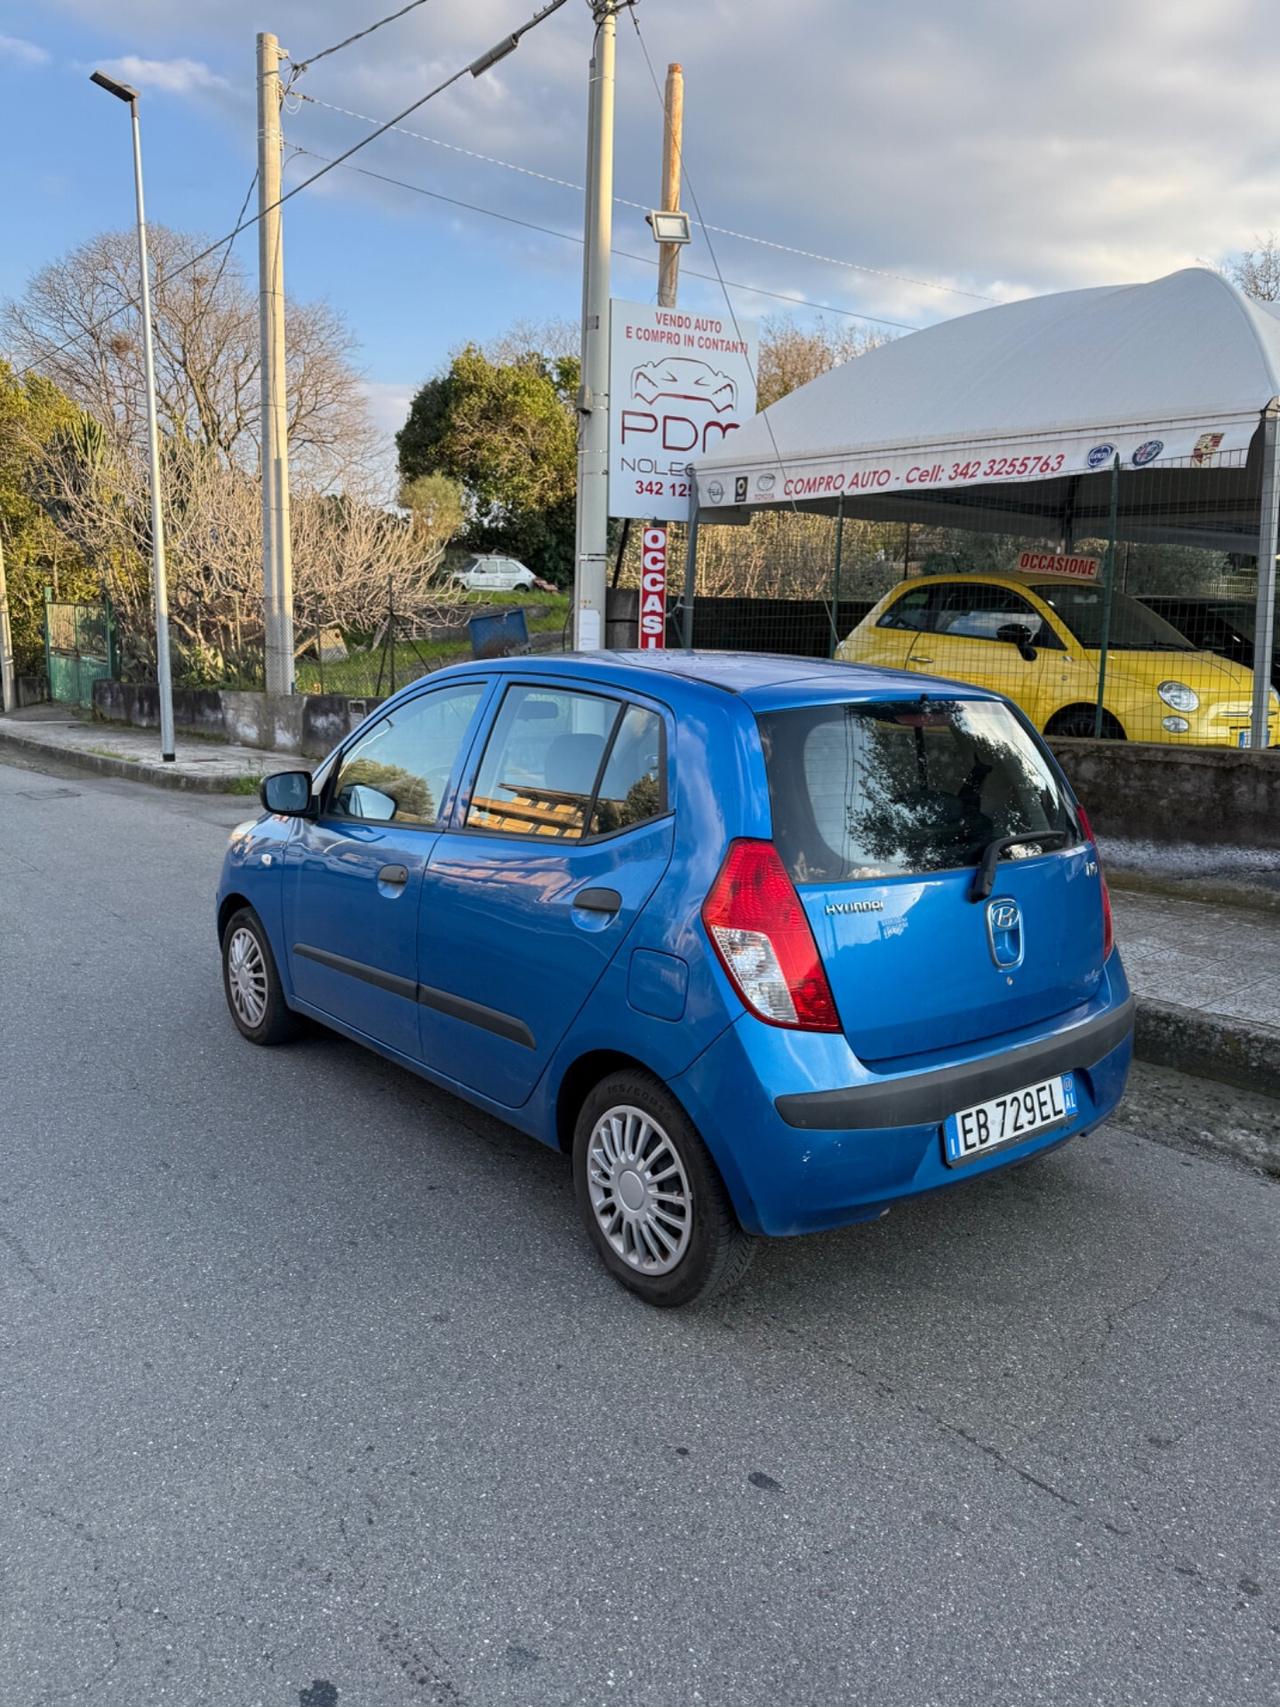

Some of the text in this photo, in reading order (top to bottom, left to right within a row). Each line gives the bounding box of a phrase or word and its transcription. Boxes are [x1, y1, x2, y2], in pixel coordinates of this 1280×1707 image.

[655, 312, 722, 334] VENDO AUTO
[625, 326, 748, 354] E COMPRO IN CONTANTI
[783, 474, 845, 496] COMPRO
[848, 470, 891, 489] AUTO
[906, 464, 945, 483] Cell:
[948, 461, 981, 481] 342
[983, 454, 1065, 476] 3255763
[635, 480, 664, 495] 342
[1020, 553, 1097, 576] OCCASIONE
[1065, 1093, 1076, 1109] AL
[961, 1083, 1063, 1151] EB 729EL
